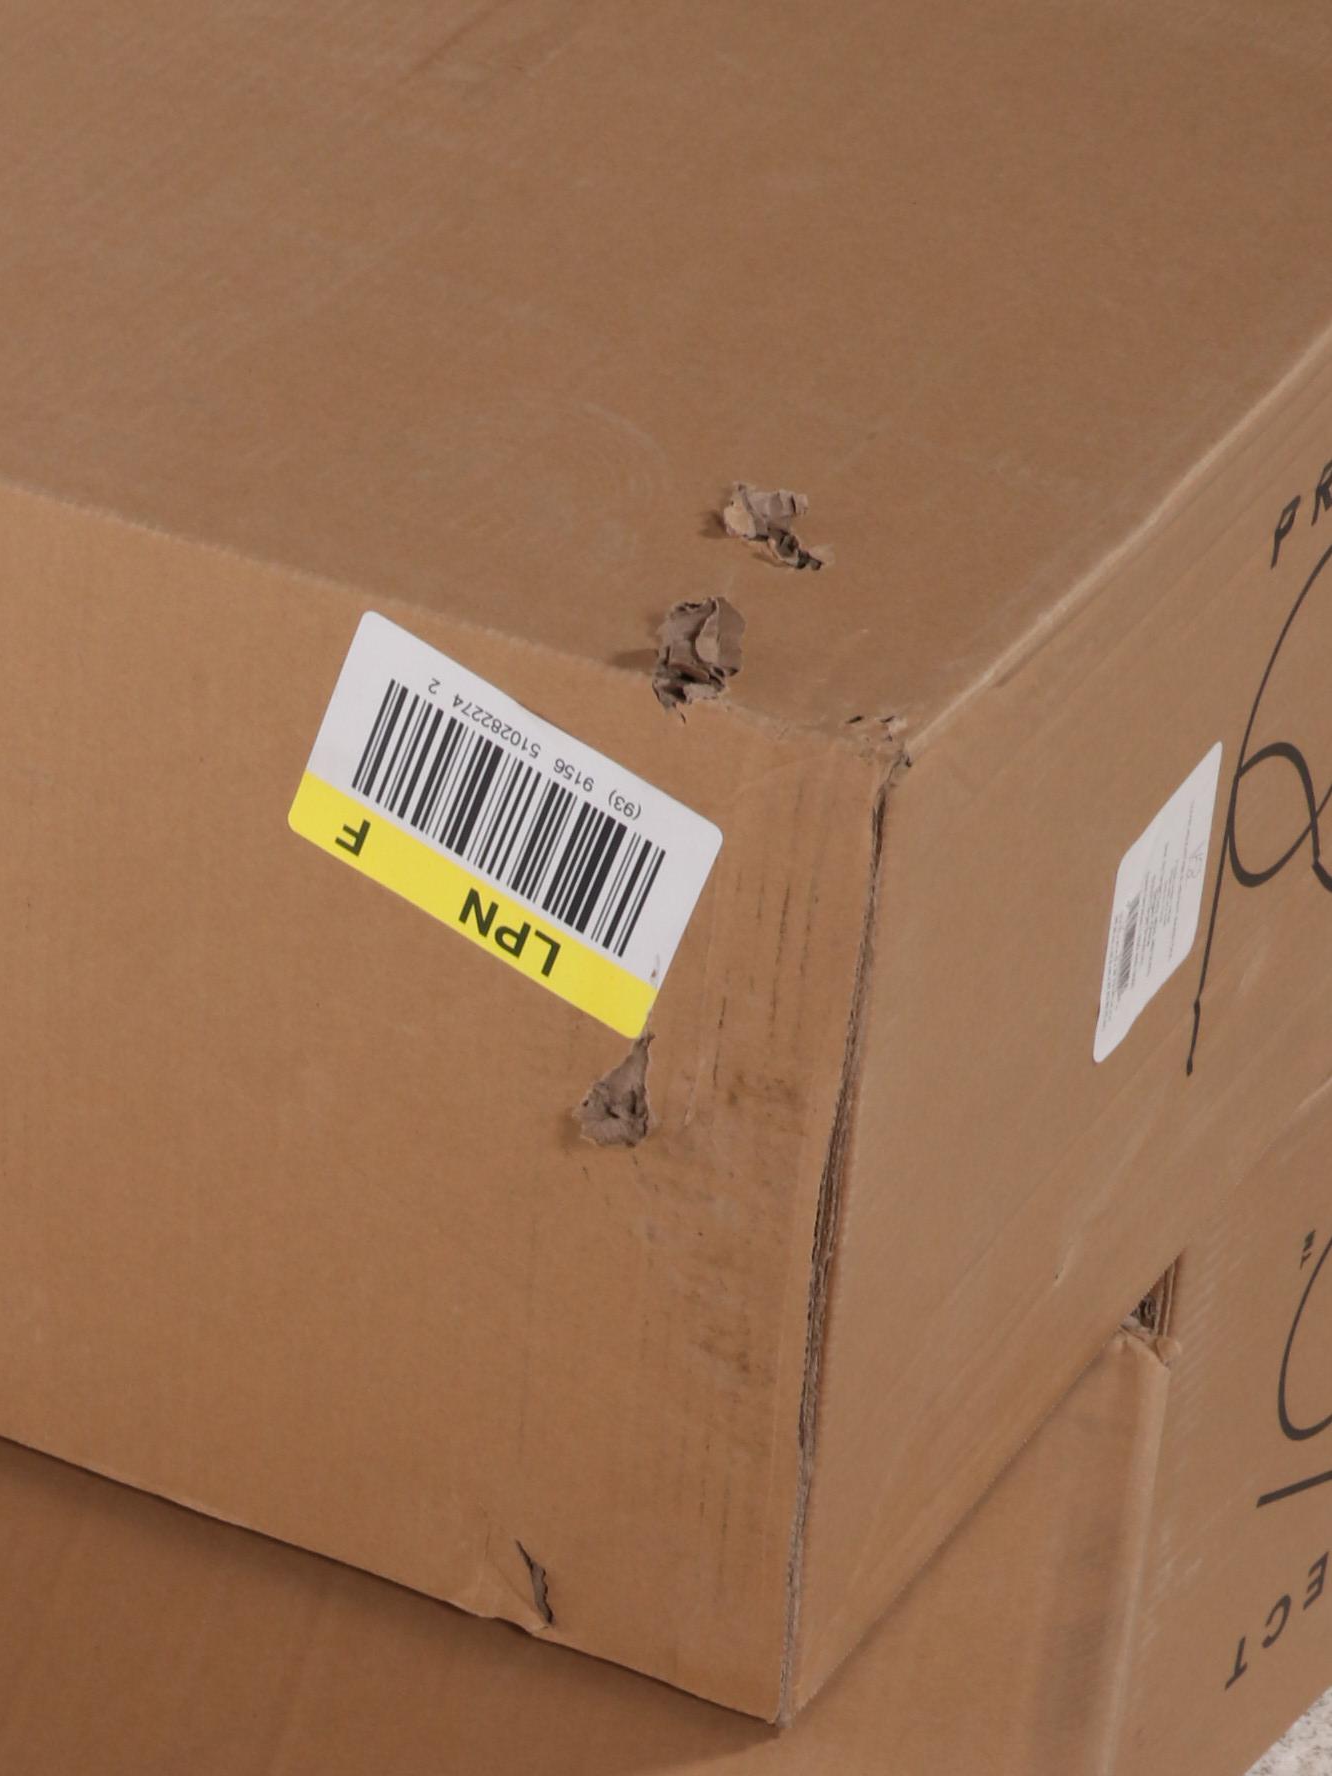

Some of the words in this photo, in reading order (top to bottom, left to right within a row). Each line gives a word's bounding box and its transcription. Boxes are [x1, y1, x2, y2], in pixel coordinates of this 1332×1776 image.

[427, 677, 441, 695] 2
[452, 693, 542, 760] 510282274
[552, 757, 595, 793] 9156
[608, 789, 643, 821] (93)
[334, 819, 372, 857] F
[458, 887, 562, 978] LPN
